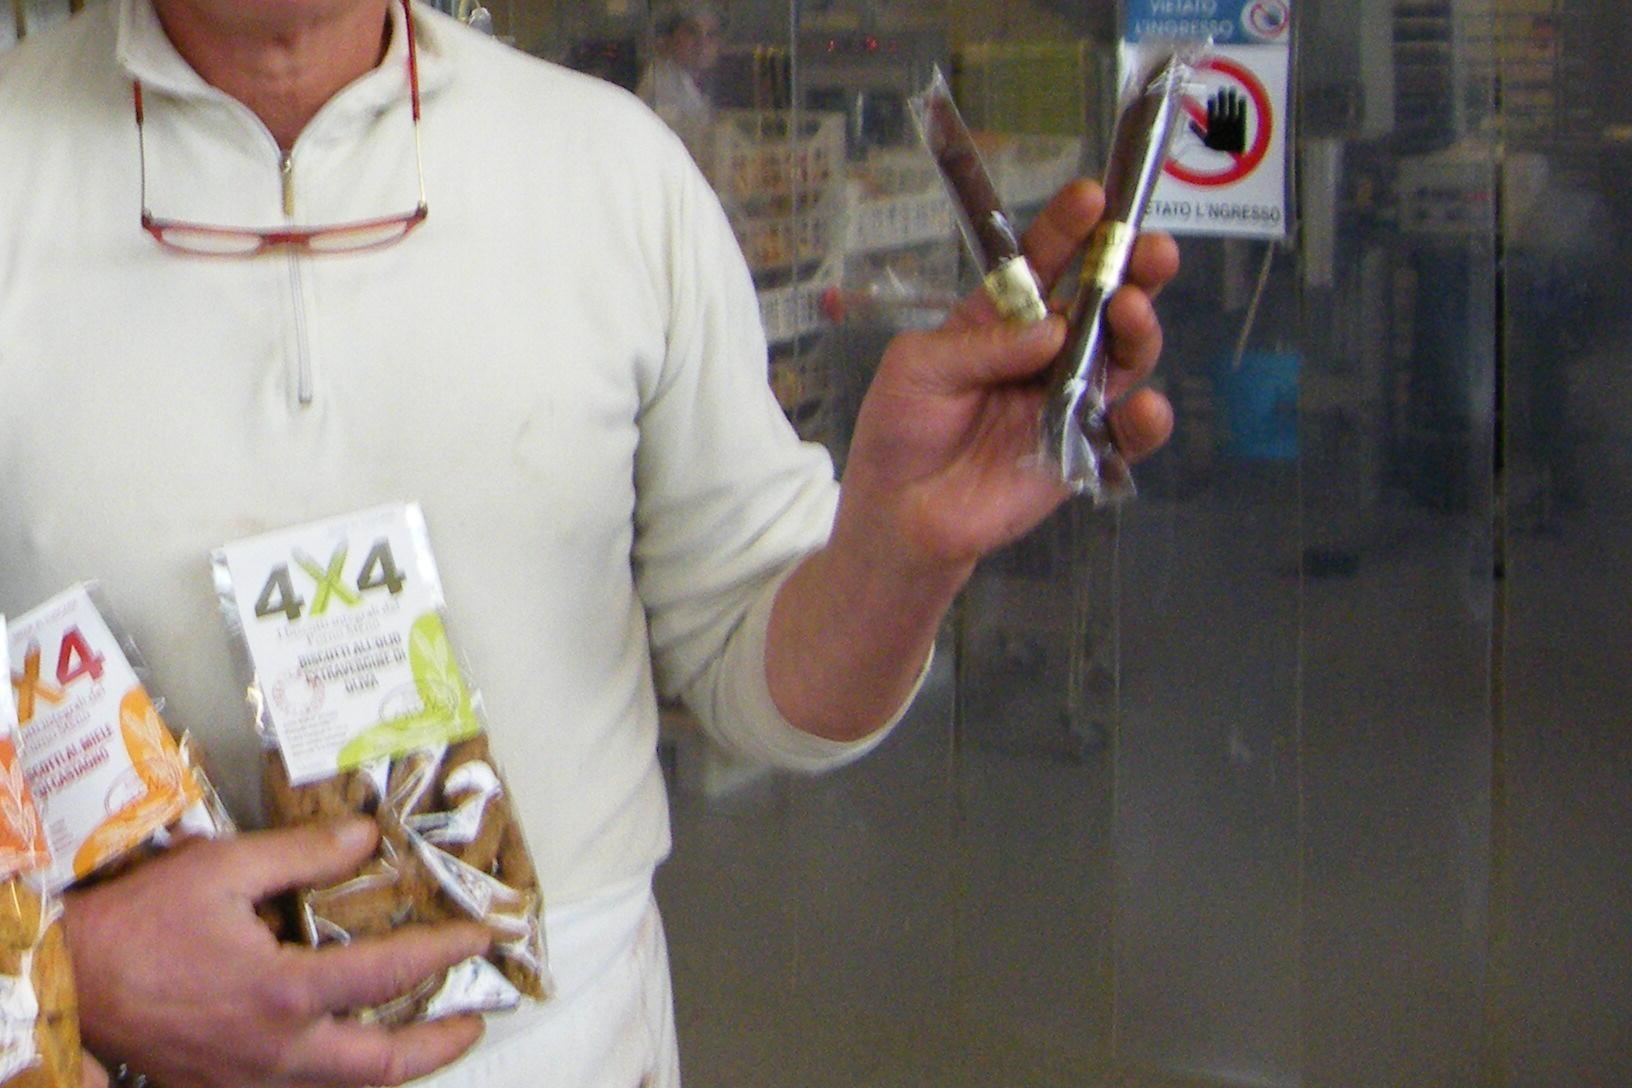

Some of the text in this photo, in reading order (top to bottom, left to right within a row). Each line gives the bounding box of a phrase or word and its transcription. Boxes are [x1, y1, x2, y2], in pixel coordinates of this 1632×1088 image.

[1134, 18, 1234, 38] L'INGRESSO
[1145, 199, 1193, 219] ETATO
[254, 534, 406, 621] 4X4
[9, 623, 106, 725] X4
[344, 672, 380, 693] OLIVA
[79, 721, 114, 752] MIELE
